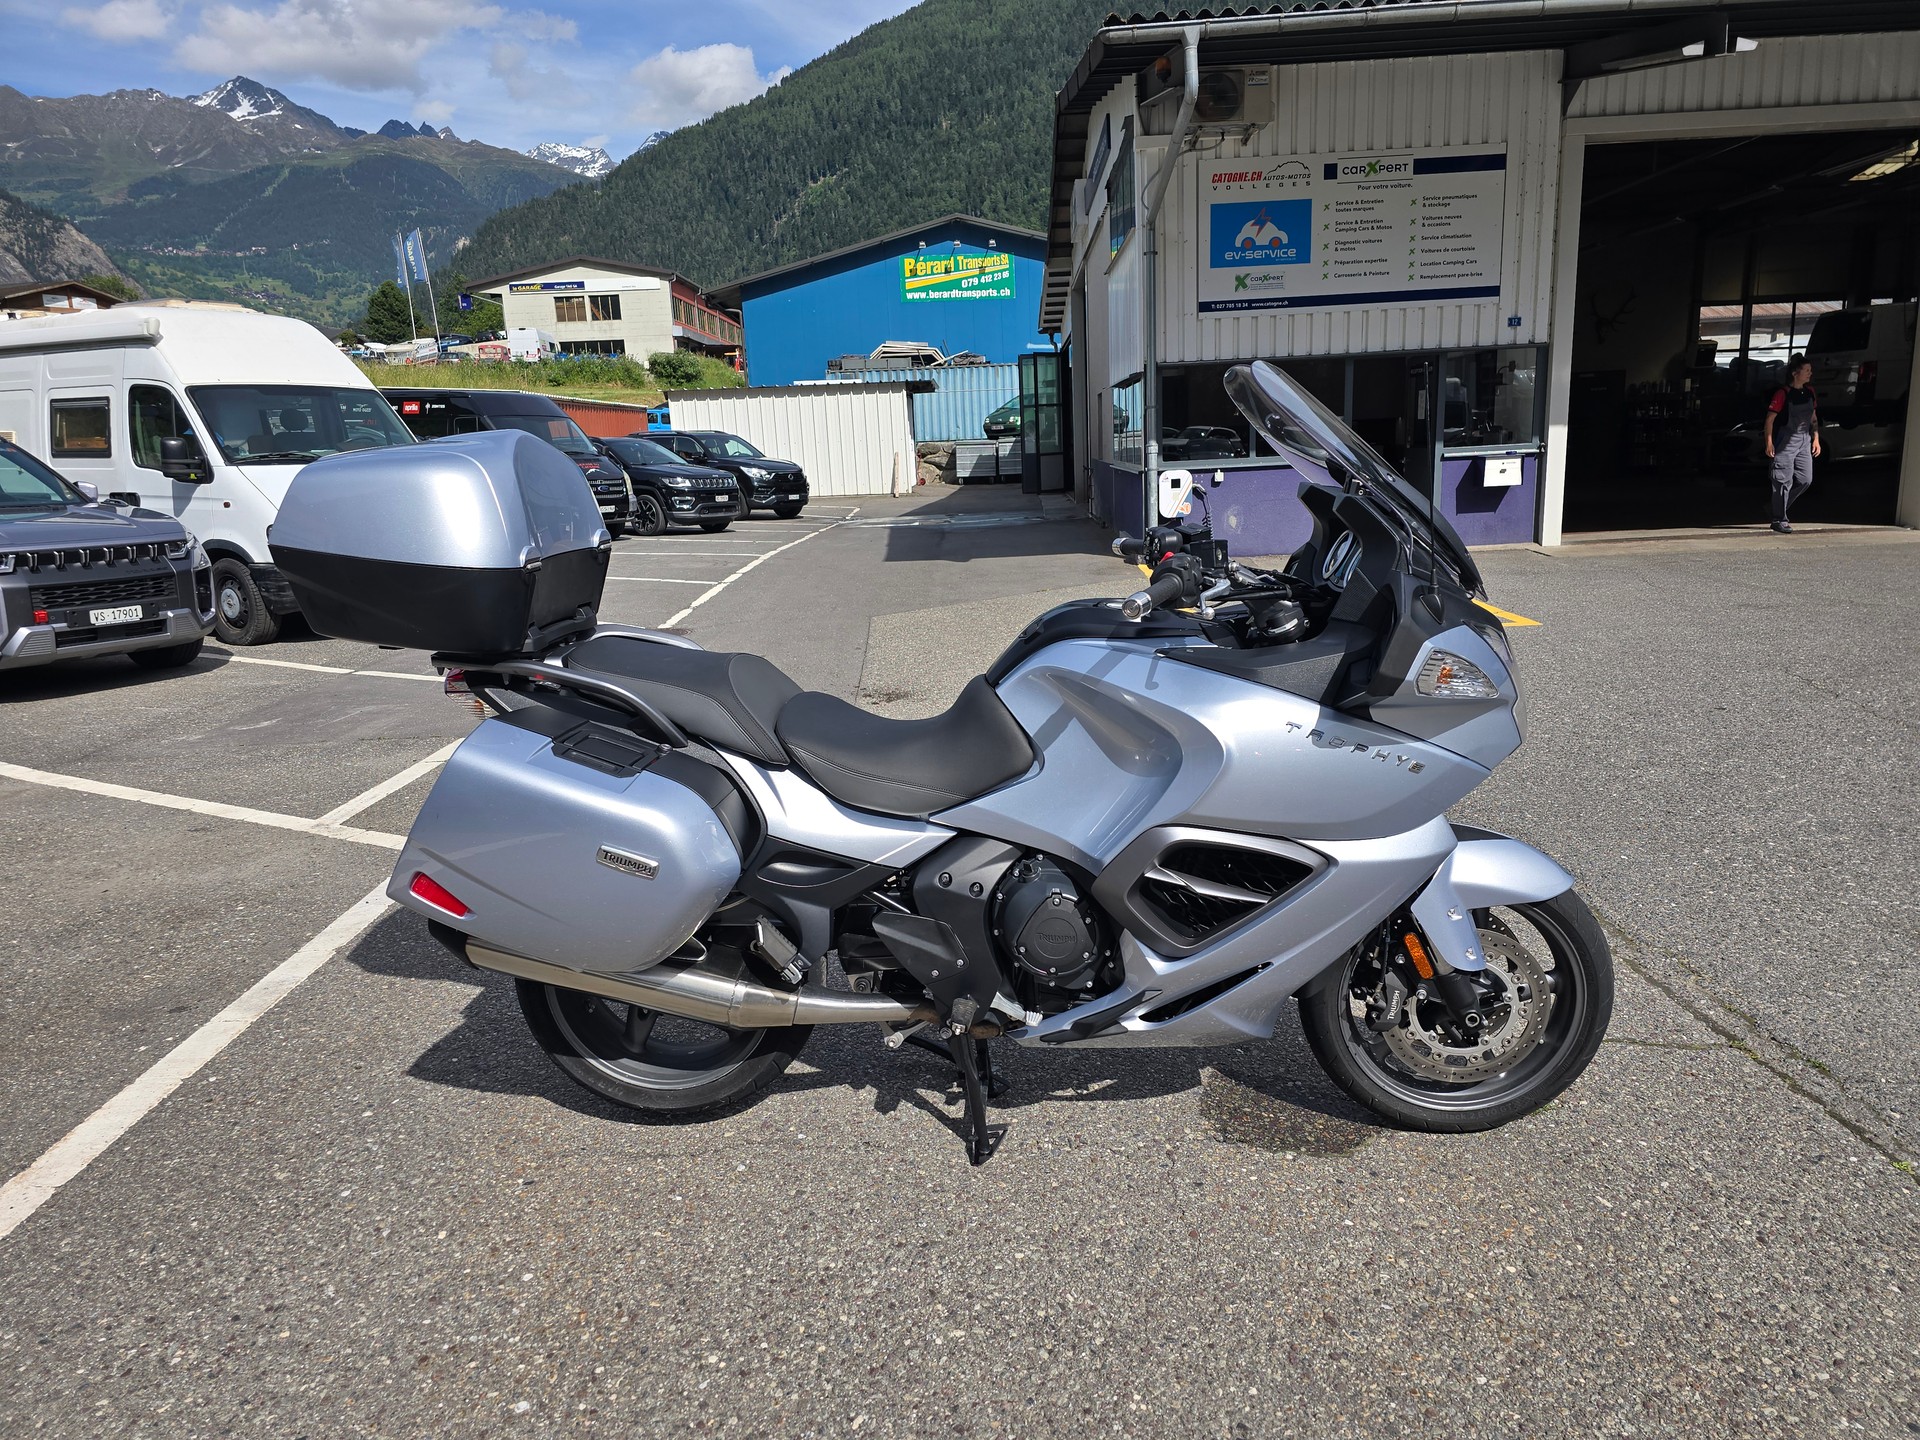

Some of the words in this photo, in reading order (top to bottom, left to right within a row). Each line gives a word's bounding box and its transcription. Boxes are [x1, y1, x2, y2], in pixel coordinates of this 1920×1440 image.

[1212, 171, 1263, 183] CATOGNE.CH
[1263, 173, 1311, 181] AUTOS-MOTOS
[1001, 254, 1009, 265] SA
[1225, 248, 1296, 260] ev-service
[961, 278, 978, 288] 079
[980, 274, 992, 284] 412
[993, 272, 1002, 280] 23
[906, 288, 1010, 300] www.berardtransports.ch
[1285, 720, 1409, 767] TROPHY
[602, 849, 653, 874] TRIUMPH
[1036, 933, 1077, 943] TRIUMPH
[1387, 990, 1400, 1020] TRIUMPH
